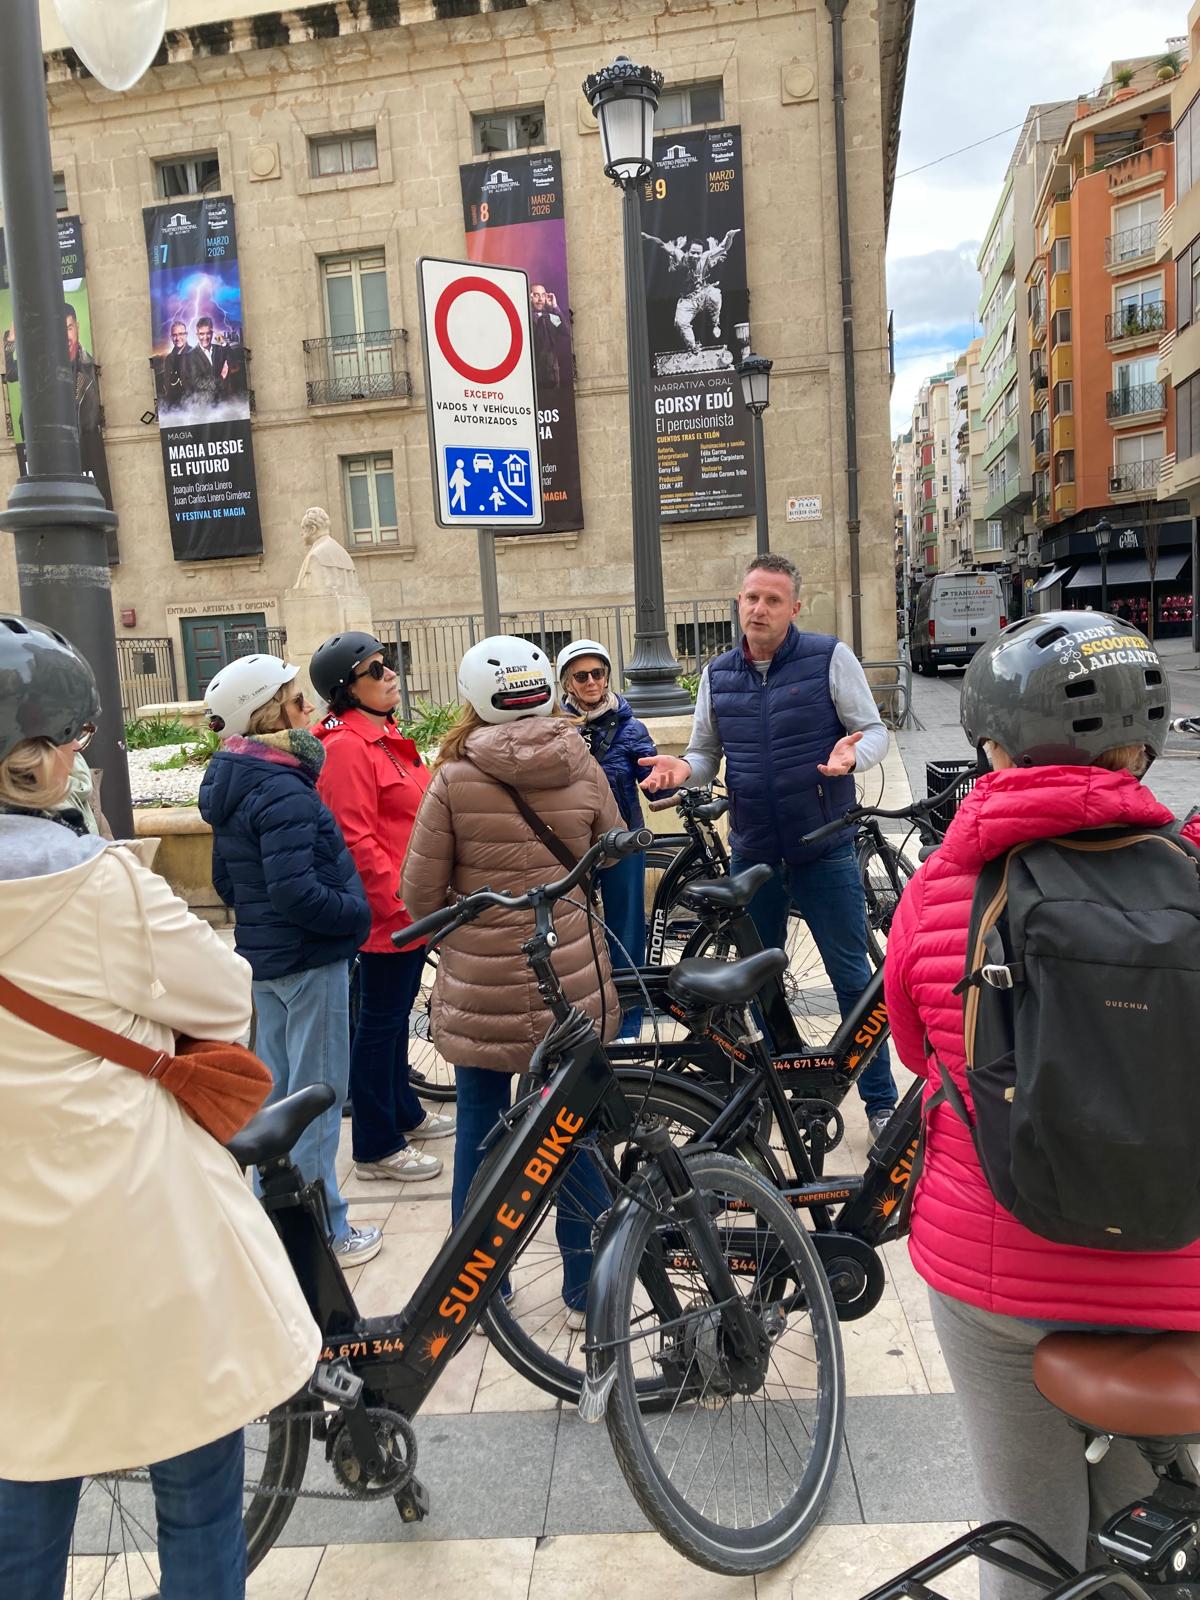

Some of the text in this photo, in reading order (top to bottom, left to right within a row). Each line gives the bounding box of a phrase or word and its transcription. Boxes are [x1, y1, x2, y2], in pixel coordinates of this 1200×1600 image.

[710, 170, 734, 182] MARZO
[656, 179, 666, 199] 9
[710, 182, 730, 193] 2026
[531, 193, 555, 205] MARZO
[480, 202, 489, 222] 8
[532, 205, 550, 216] 2026
[207, 236, 229, 246] MARZO
[160, 244, 168, 263] 7
[208, 247, 225, 257] 2026
[62, 254, 77, 264] ARZO
[61, 265, 73, 275] 026
[654, 378, 733, 392] NARRATIVA ORAL
[464, 389, 504, 400] EXCEPTO
[655, 387, 733, 414] GORSY EDÚ
[436, 401, 531, 415] VADOS Y VEHÍCULOS
[454, 415, 518, 426] AUTORIZADOS
[538, 409, 560, 423] SOS
[656, 413, 734, 434] El percusionista
[168, 432, 192, 440] MAGIA
[657, 435, 680, 443] CUENTOS
[682, 433, 695, 441] TRAS
[169, 439, 244, 460] MAGIA DESDE
[170, 458, 230, 477] EL FUTURO
[542, 462, 557, 472] rden
[196, 482, 213, 492] Gracia
[214, 481, 232, 490] Linero
[174, 491, 251, 506] Juan Carlos Linero Giménez
[544, 491, 567, 501] MAGIA
[176, 507, 246, 522] V FESTIVAL DE MAGIA
[167, 606, 197, 615] ENTRADA
[202, 604, 235, 613] ARTISTAS
[244, 601, 276, 610] OFICINAS
[1074, 625, 1116, 642] RENT
[1081, 636, 1149, 656] SCOOTER
[1089, 650, 1160, 670] ALICANTE
[506, 665, 527, 673] RENT
[509, 678, 547, 690] ALICANTE
[650, 909, 664, 966] moma
[1105, 1000, 1148, 1010] QUECHUA
[855, 1002, 888, 1048] SUN
[793, 1059, 811, 1069] 671
[814, 1058, 835, 1067] 344
[799, 1189, 850, 1202] EXPERIENCES
[438, 1106, 584, 1324] SUN E BIKE
[731, 1259, 756, 1271] 344
[340, 1342, 367, 1357] 671
[373, 1338, 404, 1354] 344
